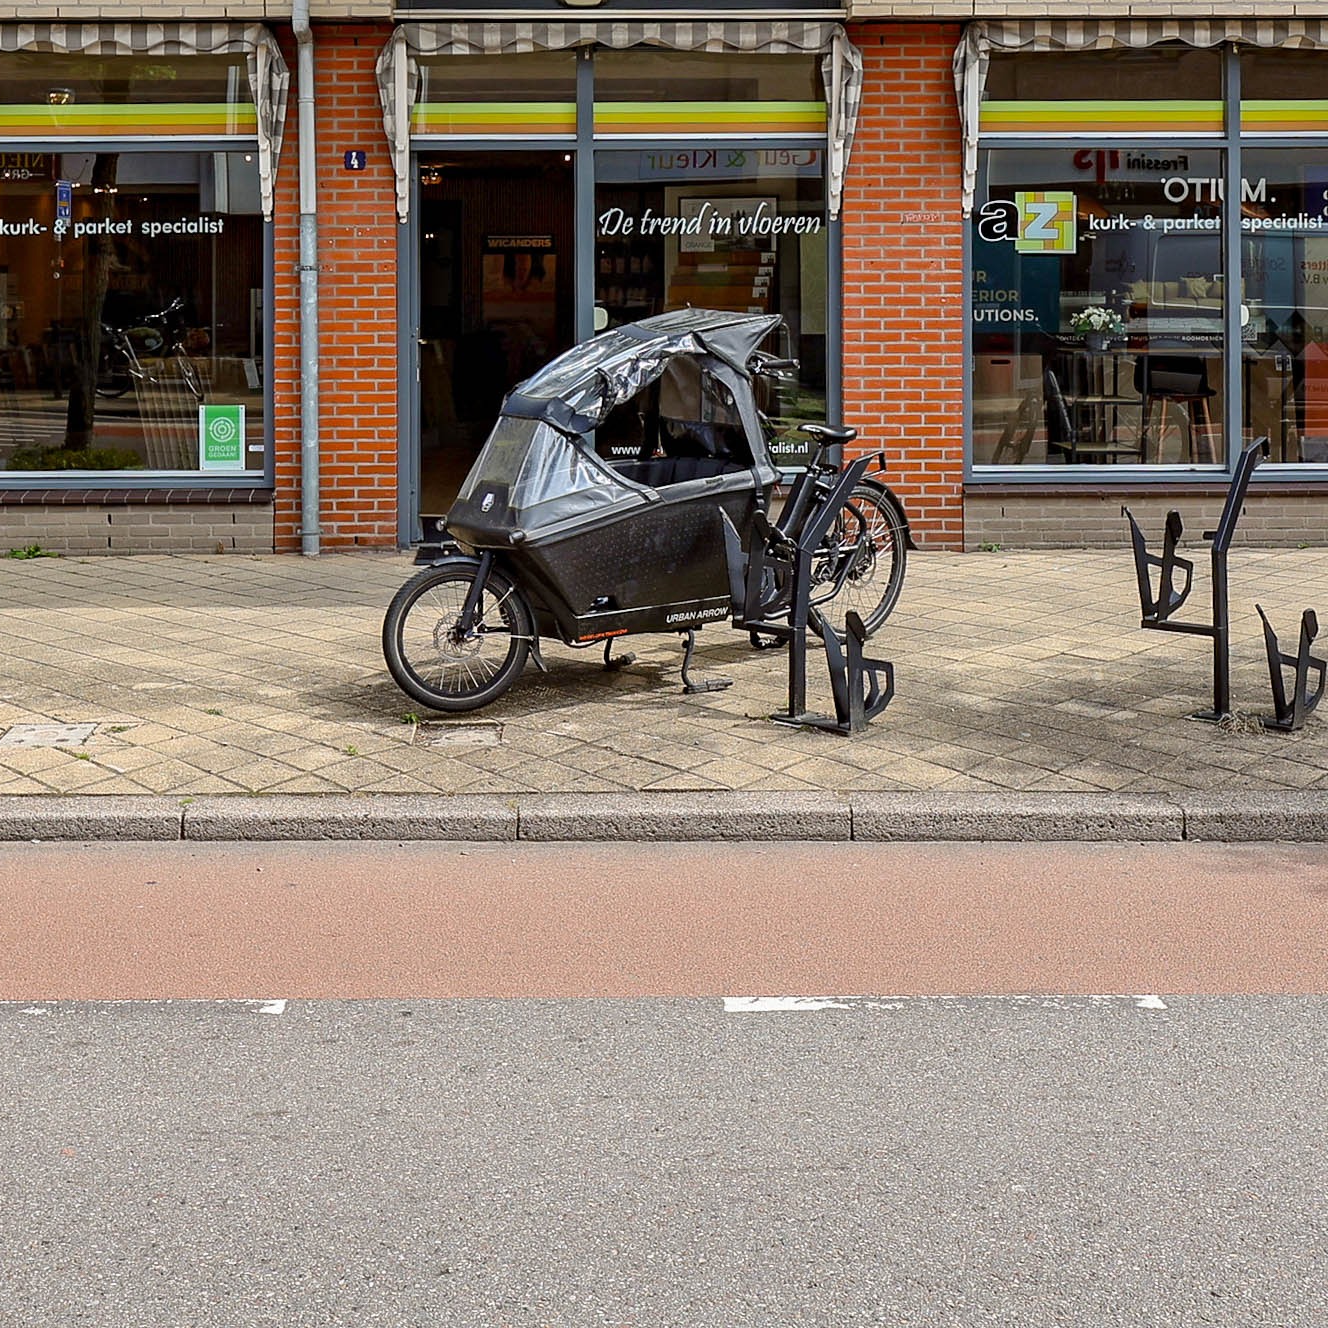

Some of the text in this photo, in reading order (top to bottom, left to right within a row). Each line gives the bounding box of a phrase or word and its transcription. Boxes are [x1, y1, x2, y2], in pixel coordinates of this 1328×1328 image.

[350, 151, 359, 169] 4
[598, 201, 821, 236] De trend in vloeren
[978, 199, 1323, 242] az kurk- & parket specialist
[53, 219, 67, 235] &
[74, 217, 133, 239] parket
[141, 217, 224, 238] specialist
[487, 238, 552, 248] WICANDERS
[971, 309, 1039, 322] UTIONS.
[665, 606, 729, 624] URBAN ARROW
